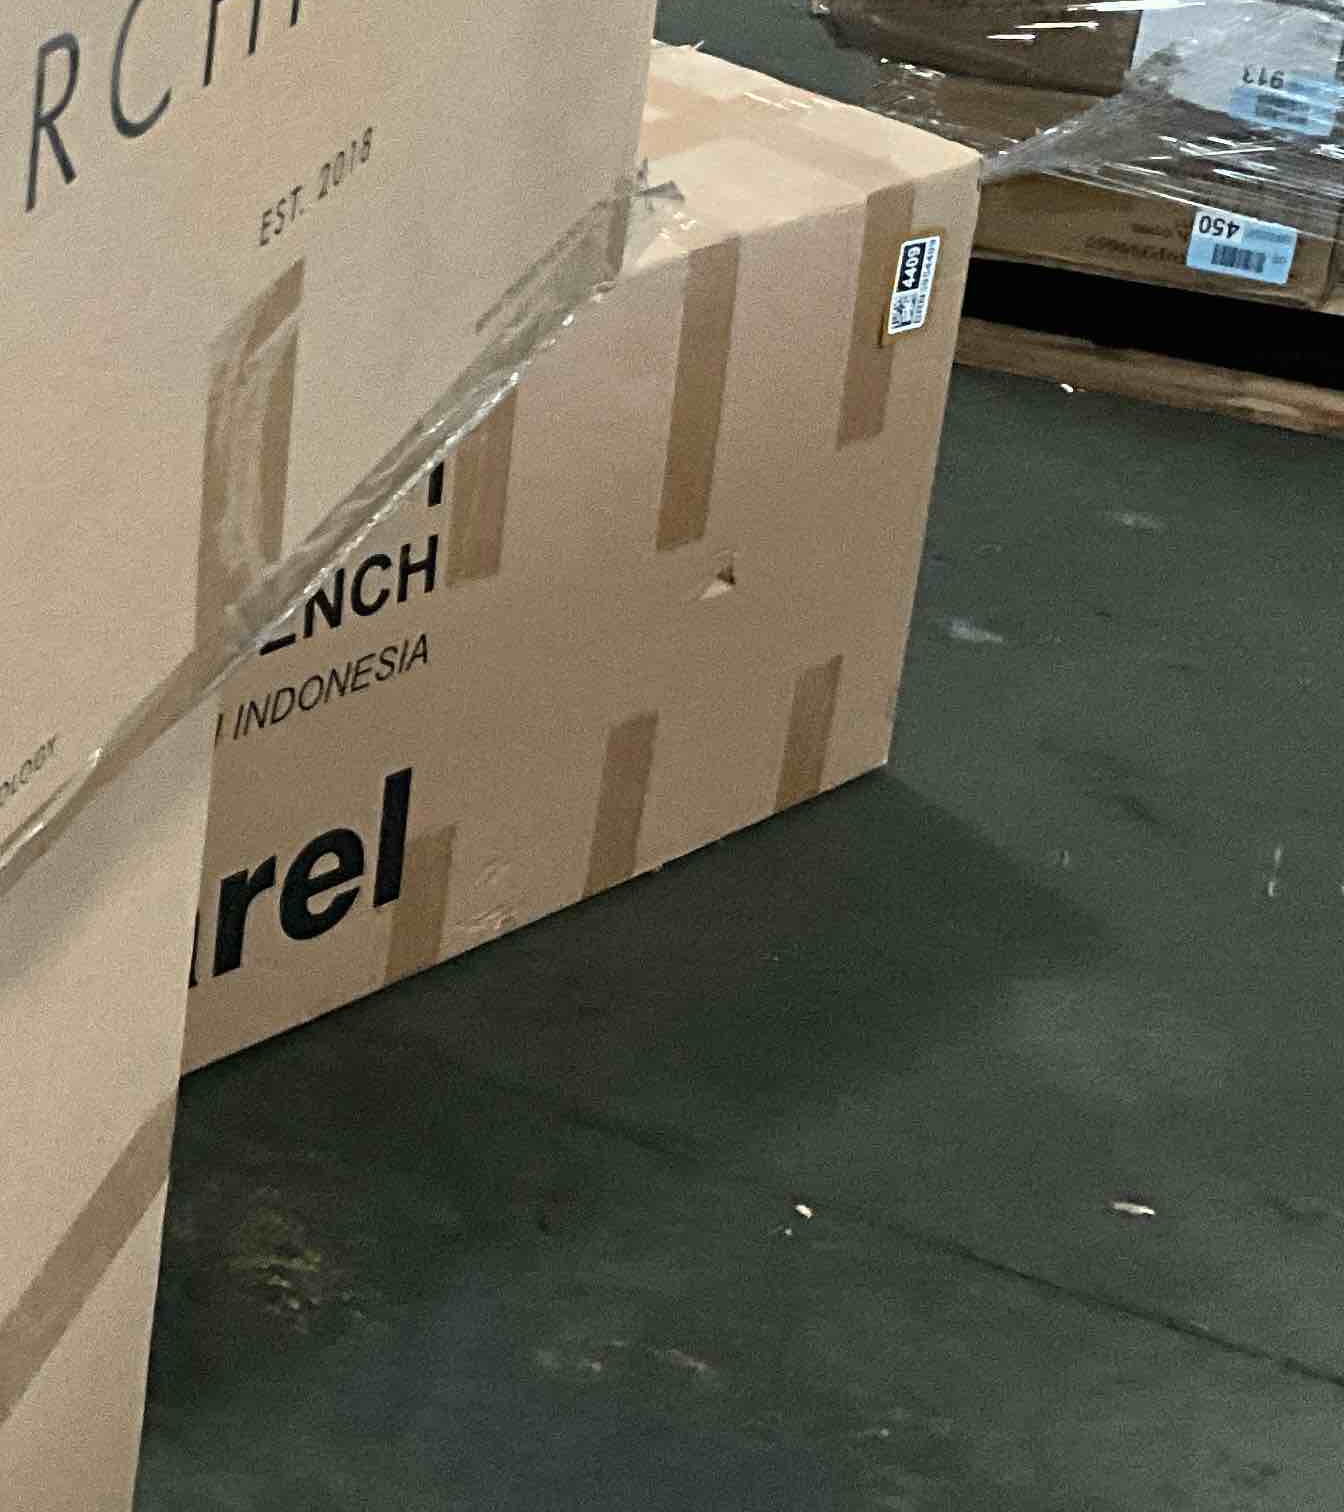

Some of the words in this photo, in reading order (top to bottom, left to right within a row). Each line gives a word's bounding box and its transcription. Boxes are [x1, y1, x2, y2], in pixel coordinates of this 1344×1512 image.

[257, 184, 305, 248] EST.
[316, 125, 376, 200] 2018
[1198, 213, 1242, 239] 450
[898, 244, 922, 292] 4409
[232, 632, 430, 743] INDONESIA
[187, 766, 413, 990] rel
